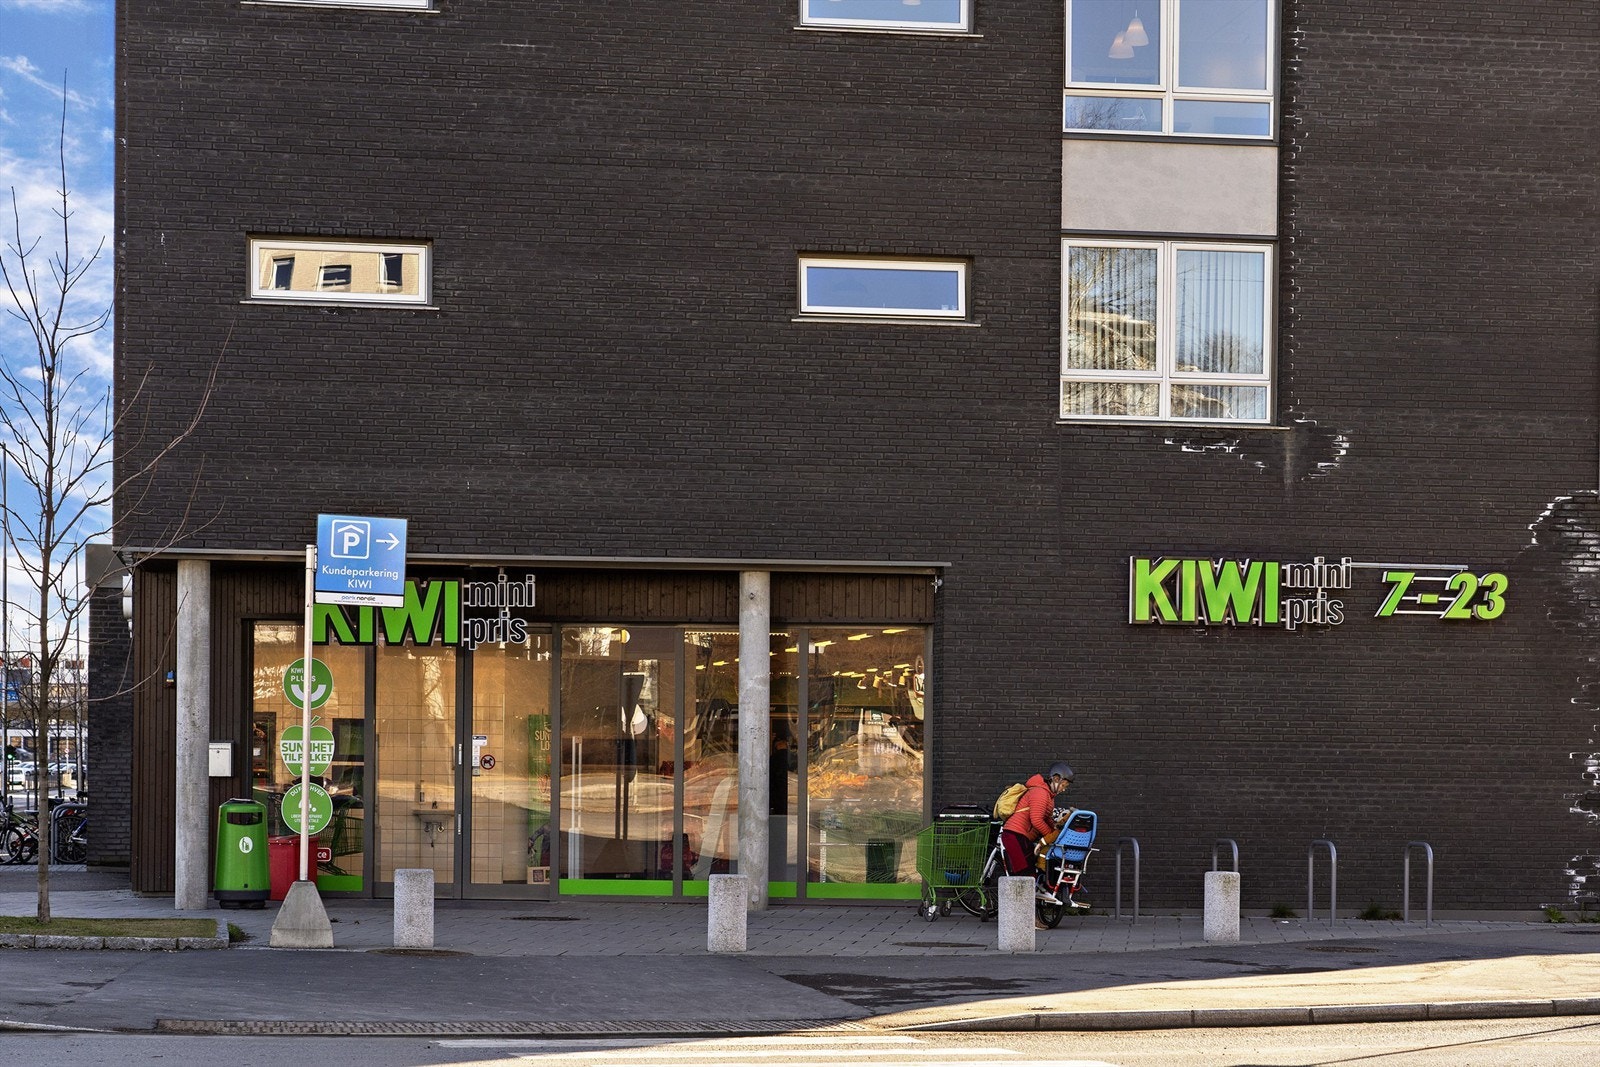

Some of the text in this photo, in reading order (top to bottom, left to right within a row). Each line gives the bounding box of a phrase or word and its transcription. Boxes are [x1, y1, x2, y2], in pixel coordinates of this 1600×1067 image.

[322, 565, 399, 581] Kundeparkering
[347, 579, 373, 590] KIWI
[469, 574, 536, 608] mini
[1134, 558, 1279, 624] KIWI
[1286, 556, 1352, 589] mini
[312, 580, 460, 644] KIWI
[1286, 591, 1346, 631] pris
[1378, 572, 1509, 620] 7-23
[469, 610, 529, 651] pris
[283, 753, 333, 762] TIL FLKET
